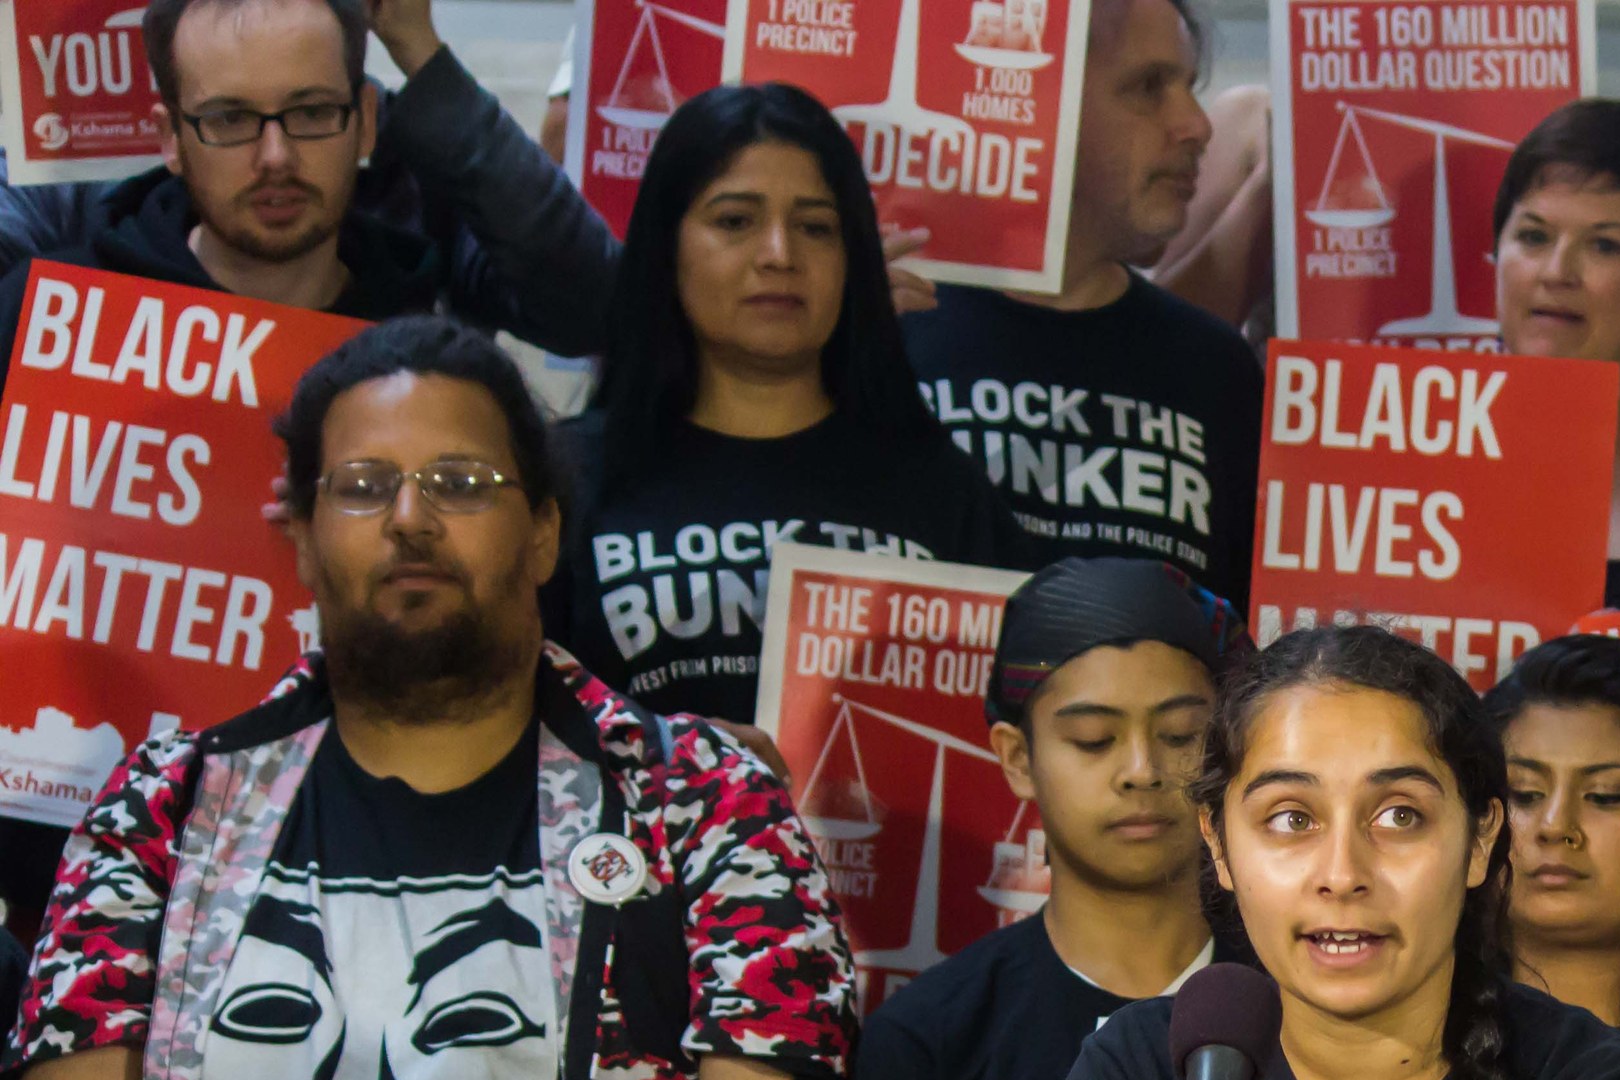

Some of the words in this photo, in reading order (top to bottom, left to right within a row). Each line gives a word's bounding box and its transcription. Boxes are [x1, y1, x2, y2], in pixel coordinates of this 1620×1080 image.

[757, 22, 857, 57] PRECINCT
[783, 0, 855, 28] POLICE
[1299, 7, 1361, 48] THE
[1374, 7, 1433, 47] 160
[1441, 5, 1568, 47] MILLION
[29, 30, 132, 97] YOU
[1302, 51, 1418, 91] DOLLAR
[1424, 50, 1571, 89] QUESTION
[962, 92, 1036, 125] HOMES
[592, 150, 648, 178] PREC
[20, 277, 276, 408] BLACK
[1100, 392, 1208, 466] THE
[1269, 355, 1509, 460] BLACK
[0, 402, 212, 528] LIVES
[951, 428, 1212, 537] UNKER
[592, 518, 805, 583] BLOCK
[1061, 521, 1092, 538] AND
[1097, 522, 1123, 543] THE
[1127, 526, 1174, 554] POLICE
[1261, 478, 1466, 582] LIVES
[0, 532, 275, 671] MATTER
[601, 568, 770, 662] BUN
[804, 581, 873, 634] THE
[887, 592, 949, 643] 160
[958, 601, 1004, 650] MI
[712, 655, 757, 675] PRISO
[796, 631, 927, 689] DOLLAR
[933, 648, 995, 698] QUE
[0, 767, 92, 803] Kshama
